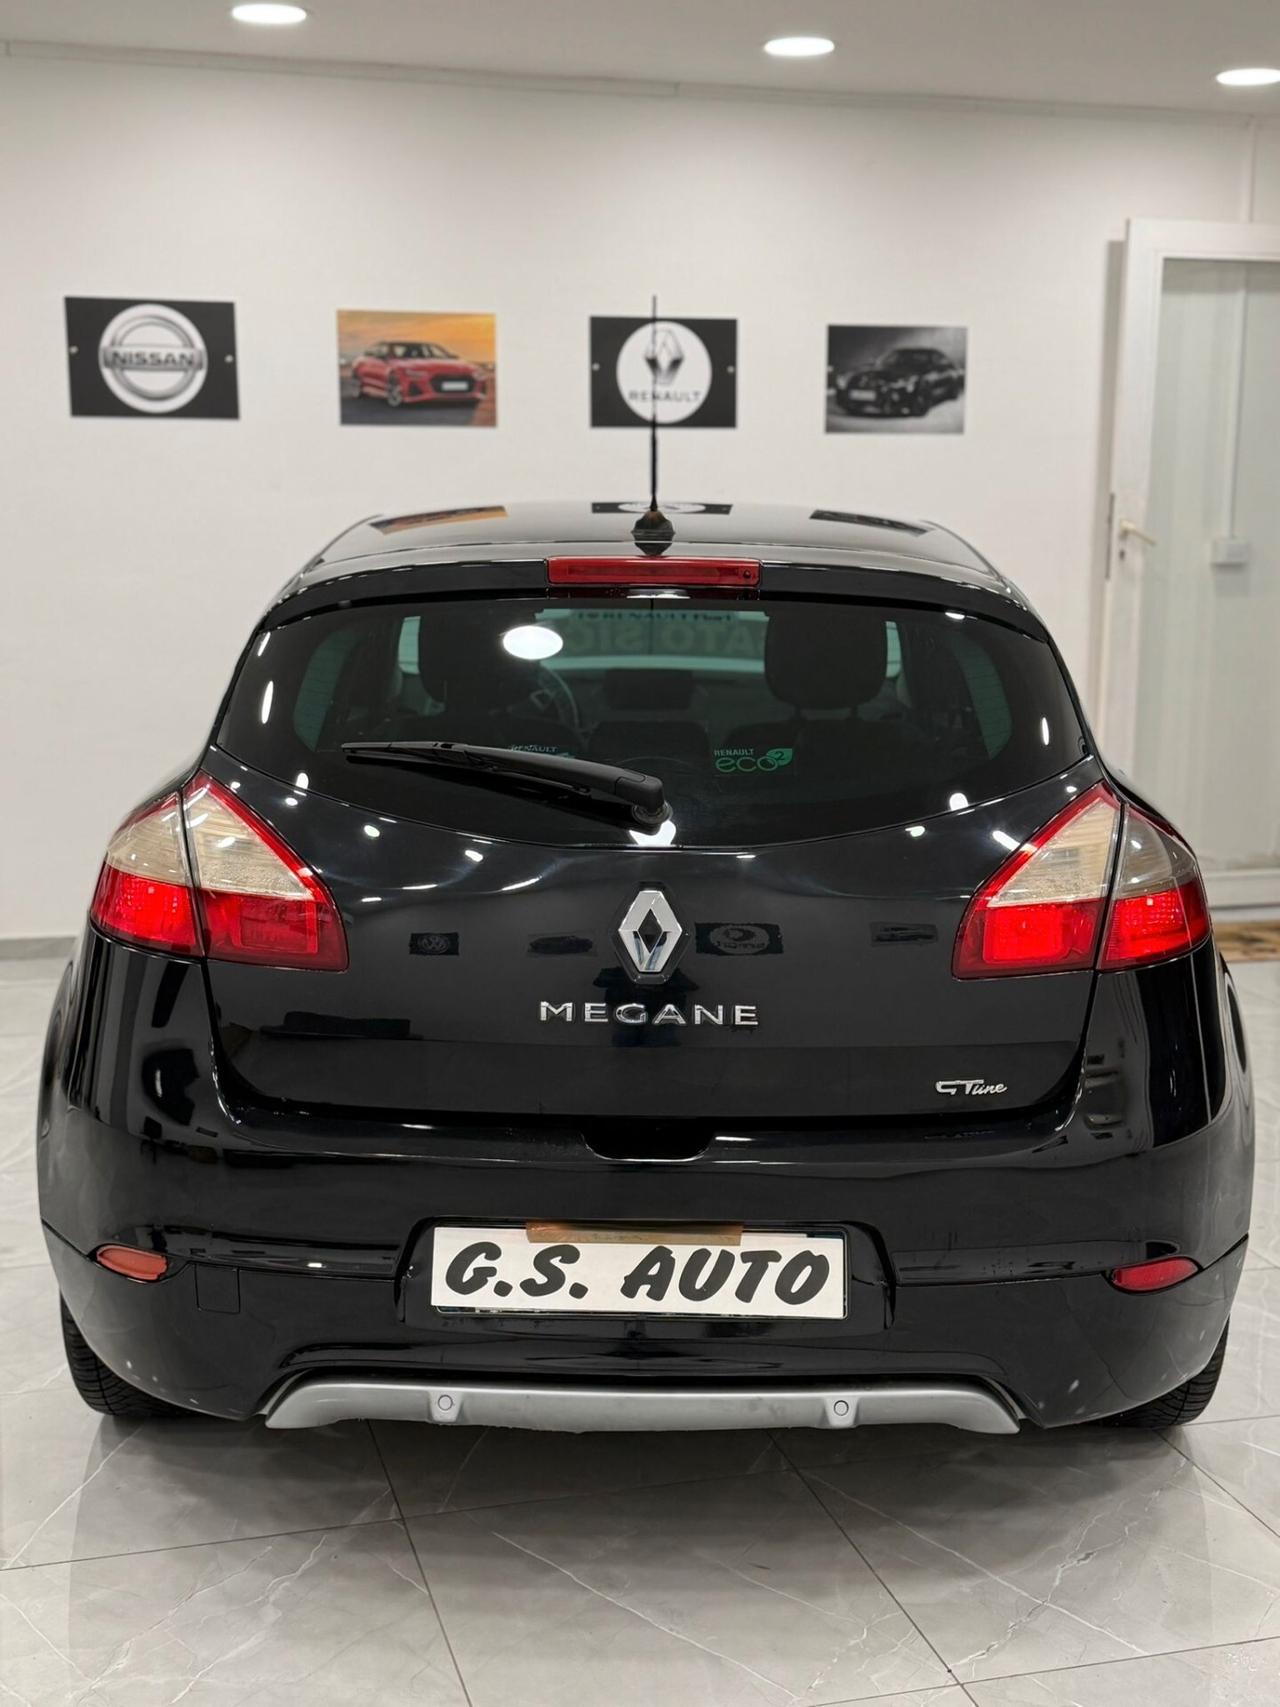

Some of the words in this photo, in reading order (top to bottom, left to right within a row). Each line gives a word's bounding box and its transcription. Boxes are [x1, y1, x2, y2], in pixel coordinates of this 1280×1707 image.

[112, 351, 194, 366] NISSAN
[629, 390, 701, 402] RENAULT
[713, 748, 754, 756] RENAULT
[540, 1001, 758, 1025] MEGANE
[445, 1241, 589, 1300] G.S.
[619, 1245, 831, 1306] AUTO
